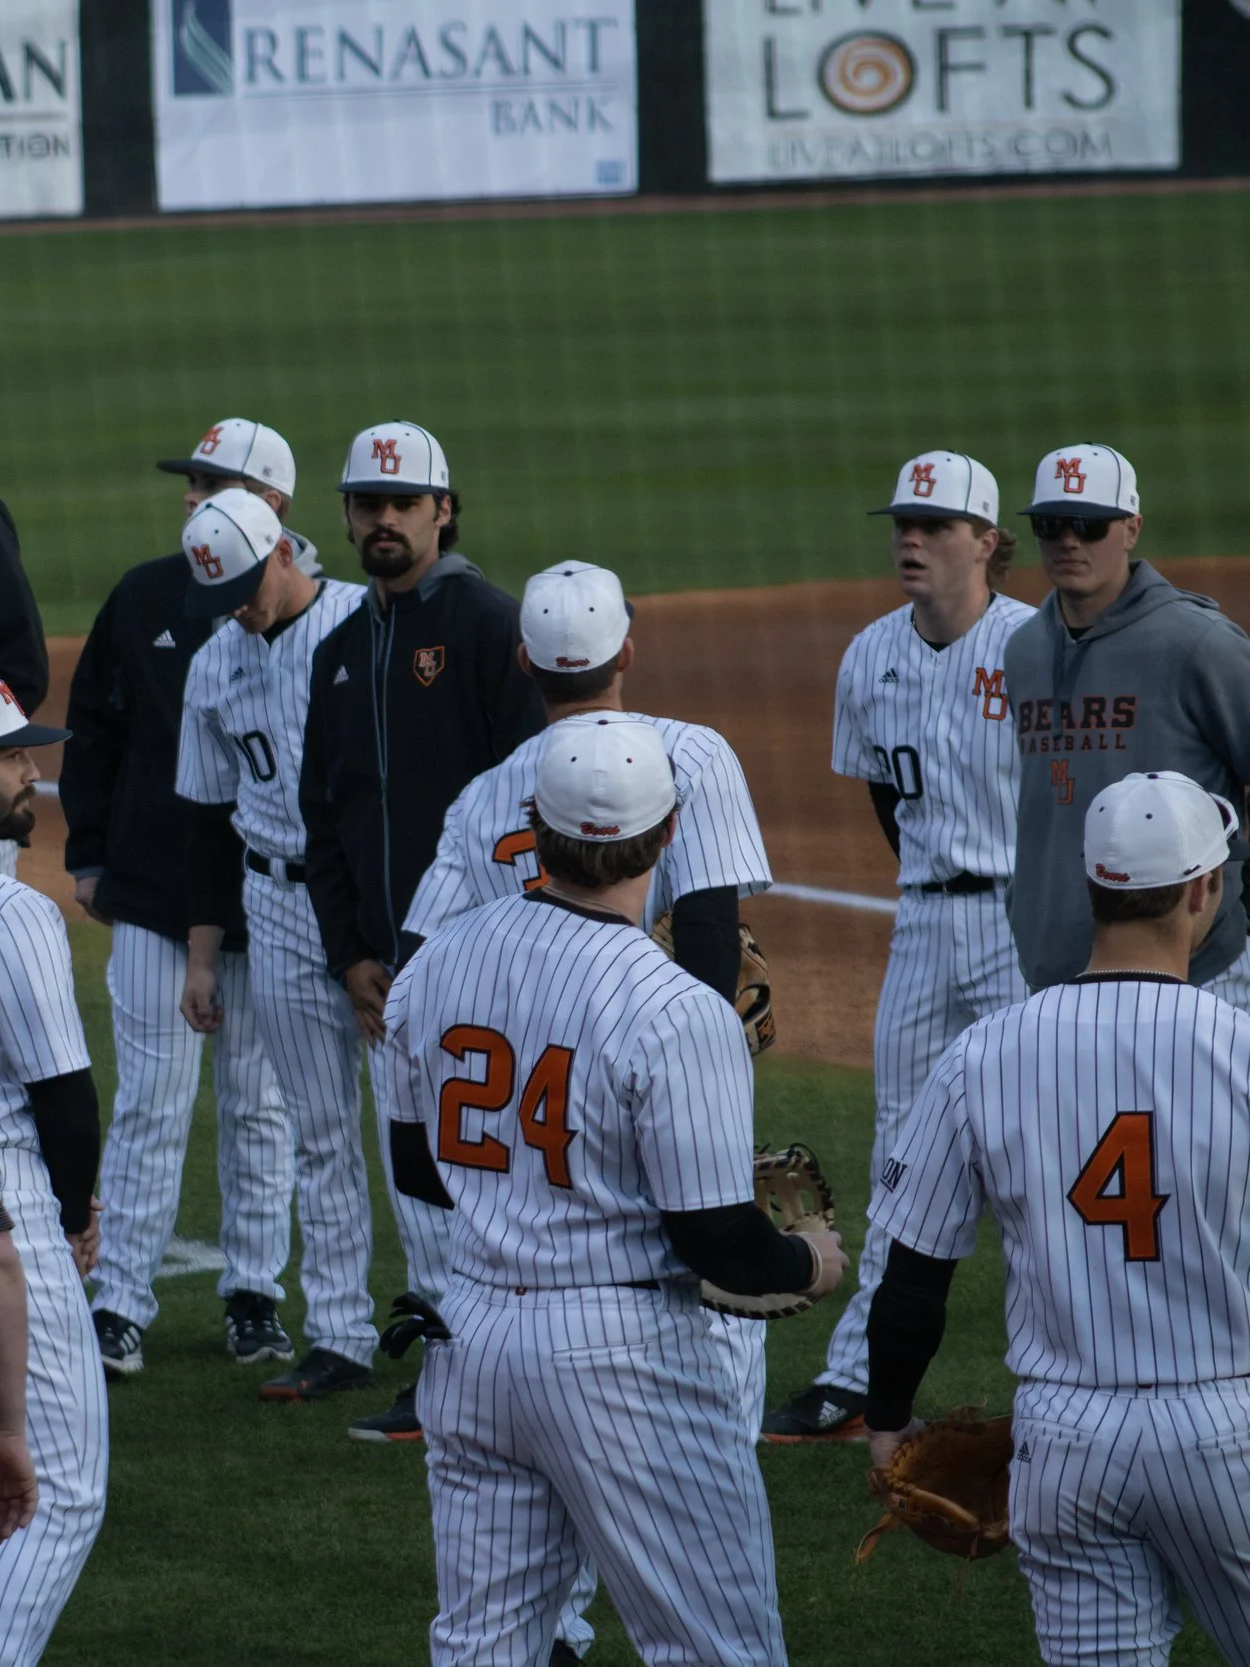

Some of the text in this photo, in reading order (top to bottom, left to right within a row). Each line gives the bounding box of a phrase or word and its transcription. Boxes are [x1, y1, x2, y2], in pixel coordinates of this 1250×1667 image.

[243, 16, 618, 84] RENASANT
[763, 23, 1117, 119] LOFTS
[492, 96, 613, 136] BANK
[371, 438, 401, 475] MU
[1054, 457, 1086, 493] MU
[909, 463, 936, 497] MU
[191, 543, 224, 579] MU
[972, 667, 1007, 720] MU
[1018, 696, 1137, 734] BEARS
[1051, 758, 1075, 805] MU
[437, 1024, 580, 1190] 24
[1066, 1110, 1171, 1262] 4
